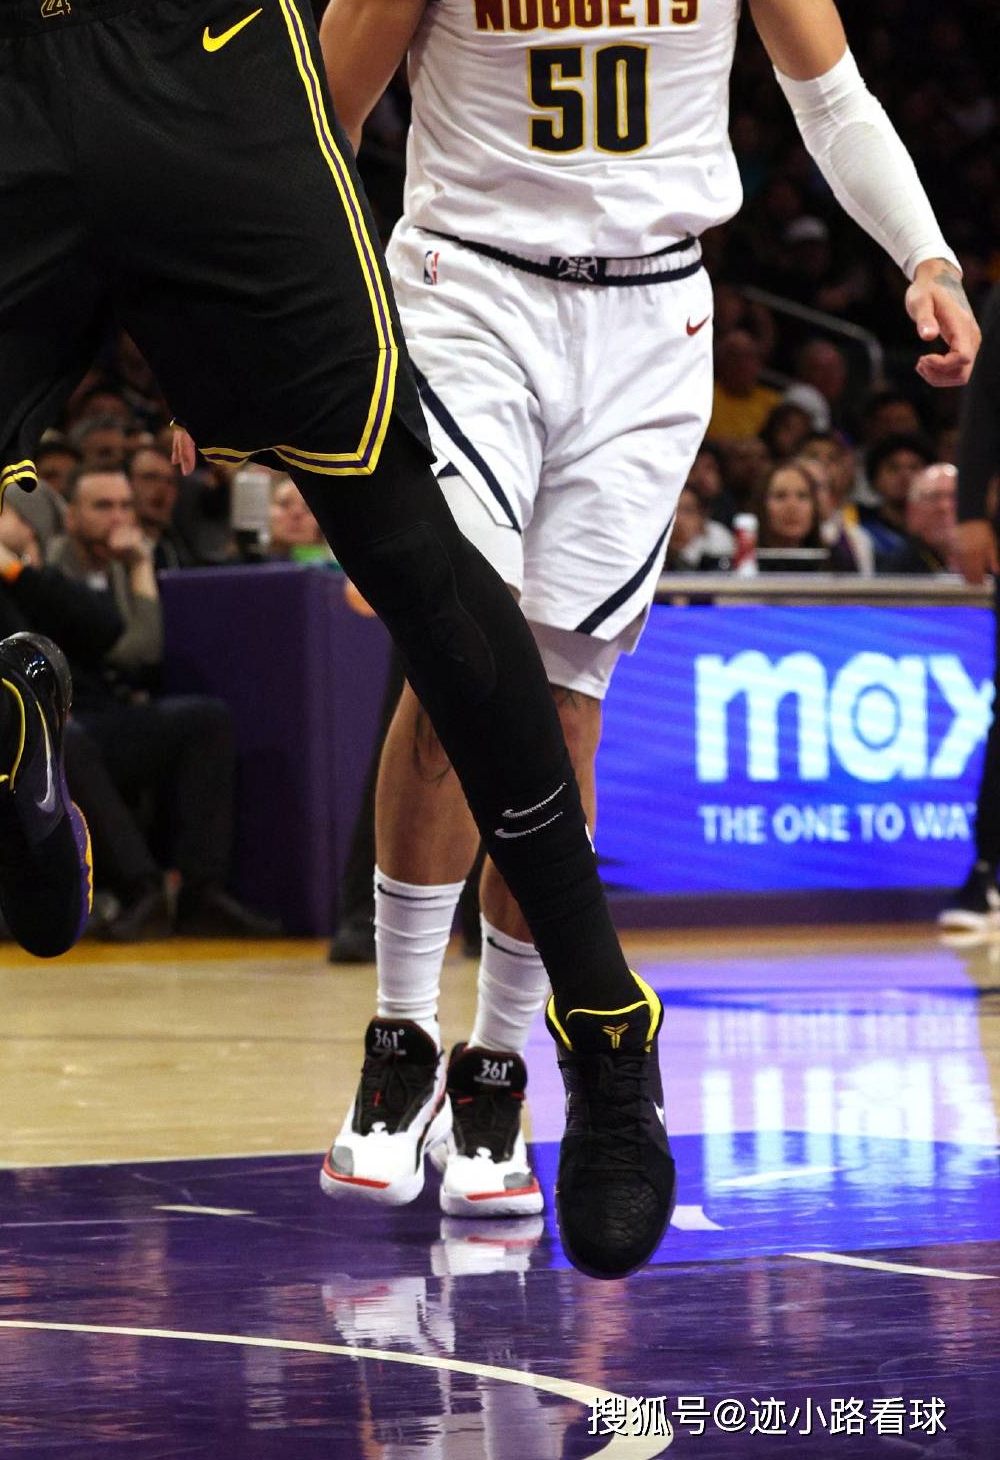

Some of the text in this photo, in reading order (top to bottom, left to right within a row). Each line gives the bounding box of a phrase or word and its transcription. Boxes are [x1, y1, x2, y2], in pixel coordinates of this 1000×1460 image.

[527, 41, 650, 156] 50
[694, 650, 994, 783] max
[700, 804, 767, 844] THE
[772, 803, 850, 844] ONE
[856, 802, 905, 841] TO
